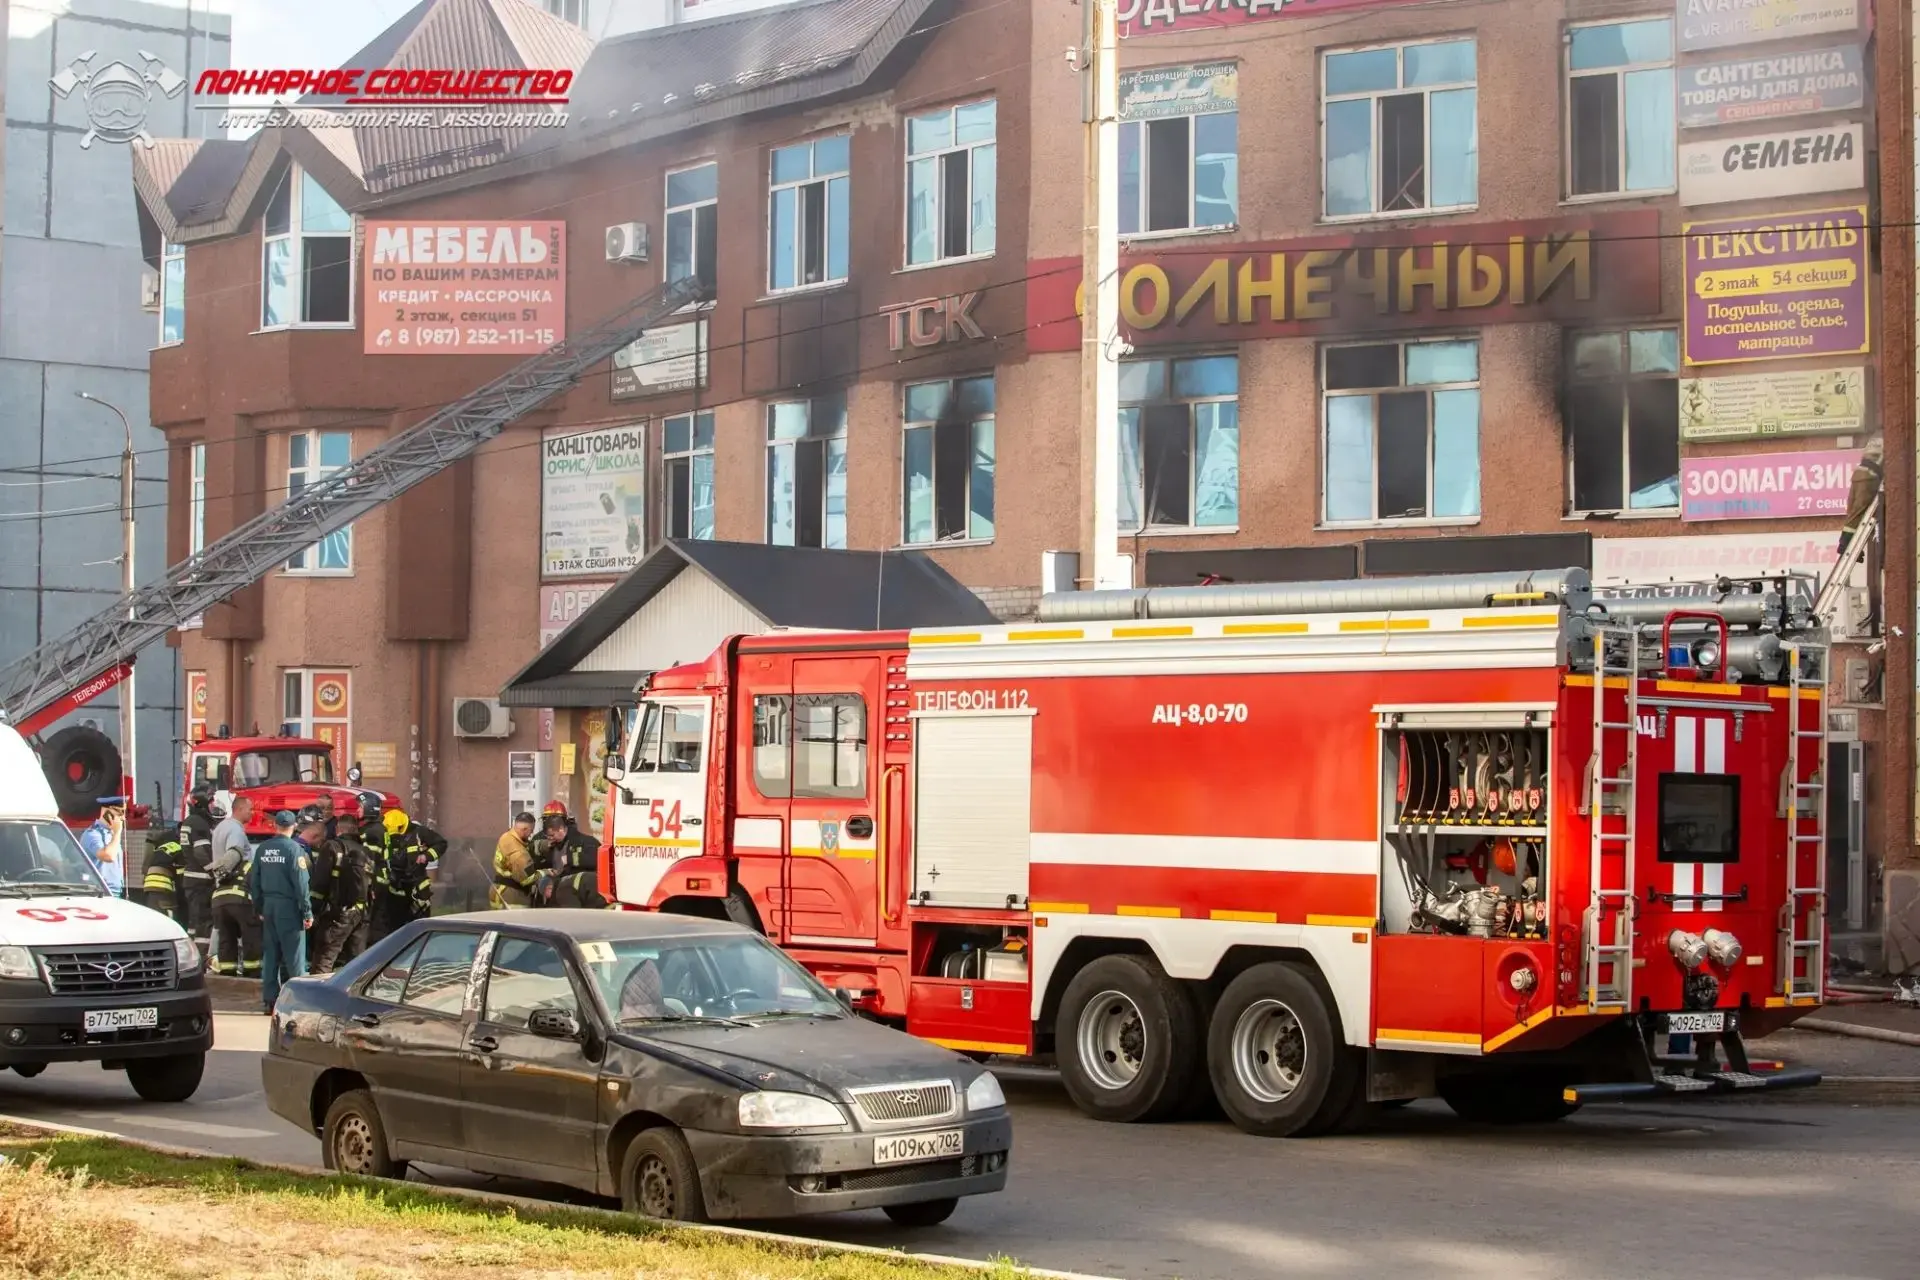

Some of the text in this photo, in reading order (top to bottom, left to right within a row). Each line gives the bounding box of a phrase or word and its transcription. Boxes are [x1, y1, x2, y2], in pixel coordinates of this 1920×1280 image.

[1129, 70, 1189, 84] РЕСТАВРАЦИИ
[1191, 65, 1236, 79] ПОДУШЕК
[1694, 52, 1845, 86] САНТЕХНИКА
[1681, 72, 1858, 106] ТОВАРЫ ДЛЯ ДОМА
[1722, 132, 1853, 173] СЕМЕНА
[373, 226, 547, 264] МЕБЕЛЬ
[1692, 218, 1858, 261] ТЕКСТИЛЬ
[372, 267, 559, 281] ПО ВАШИМ РАЗМЕРАМ
[1075, 229, 1590, 330] ОЛНЕЧНЫЙ
[1703, 267, 1848, 291] 2 этаж 54 секция
[378, 290, 552, 304] КРЕДИТ РАССРОЧКА
[396, 308, 537, 324] 2 этаж, секция 51
[1707, 297, 1845, 321] Подушки, одеяла,
[879, 291, 985, 351] ТСК
[1704, 314, 1848, 336] постельное белье,
[398, 327, 554, 346] 8 (987) 252-11-15
[1738, 334, 1814, 351] матрацы
[547, 431, 641, 457] КАНЦТОВАРЫ
[547, 453, 641, 475] ОФИС ШКОЛА
[1797, 497, 1812, 510] 27
[1816, 497, 1848, 510] секц
[552, 556, 637, 570] 1 ЭТАЖ СЕКЦИЯ №32
[1605, 541, 1839, 571] Парикмахерска
[548, 590, 606, 621] АРЕ
[72, 678, 108, 704] ТЕЛЕФОН
[915, 689, 1029, 711] ТЕЛЕФОН 112
[1152, 704, 1248, 726] АЦ-8,0-70
[648, 799, 682, 839] 54
[614, 845, 680, 859] СТЕРПИТАМАК
[16, 906, 108, 923] 03
[88, 1009, 155, 1027] В775МТ 702
[1670, 1014, 1721, 1031] М092ЕА 702
[878, 1133, 960, 1160] М109КХ 702
